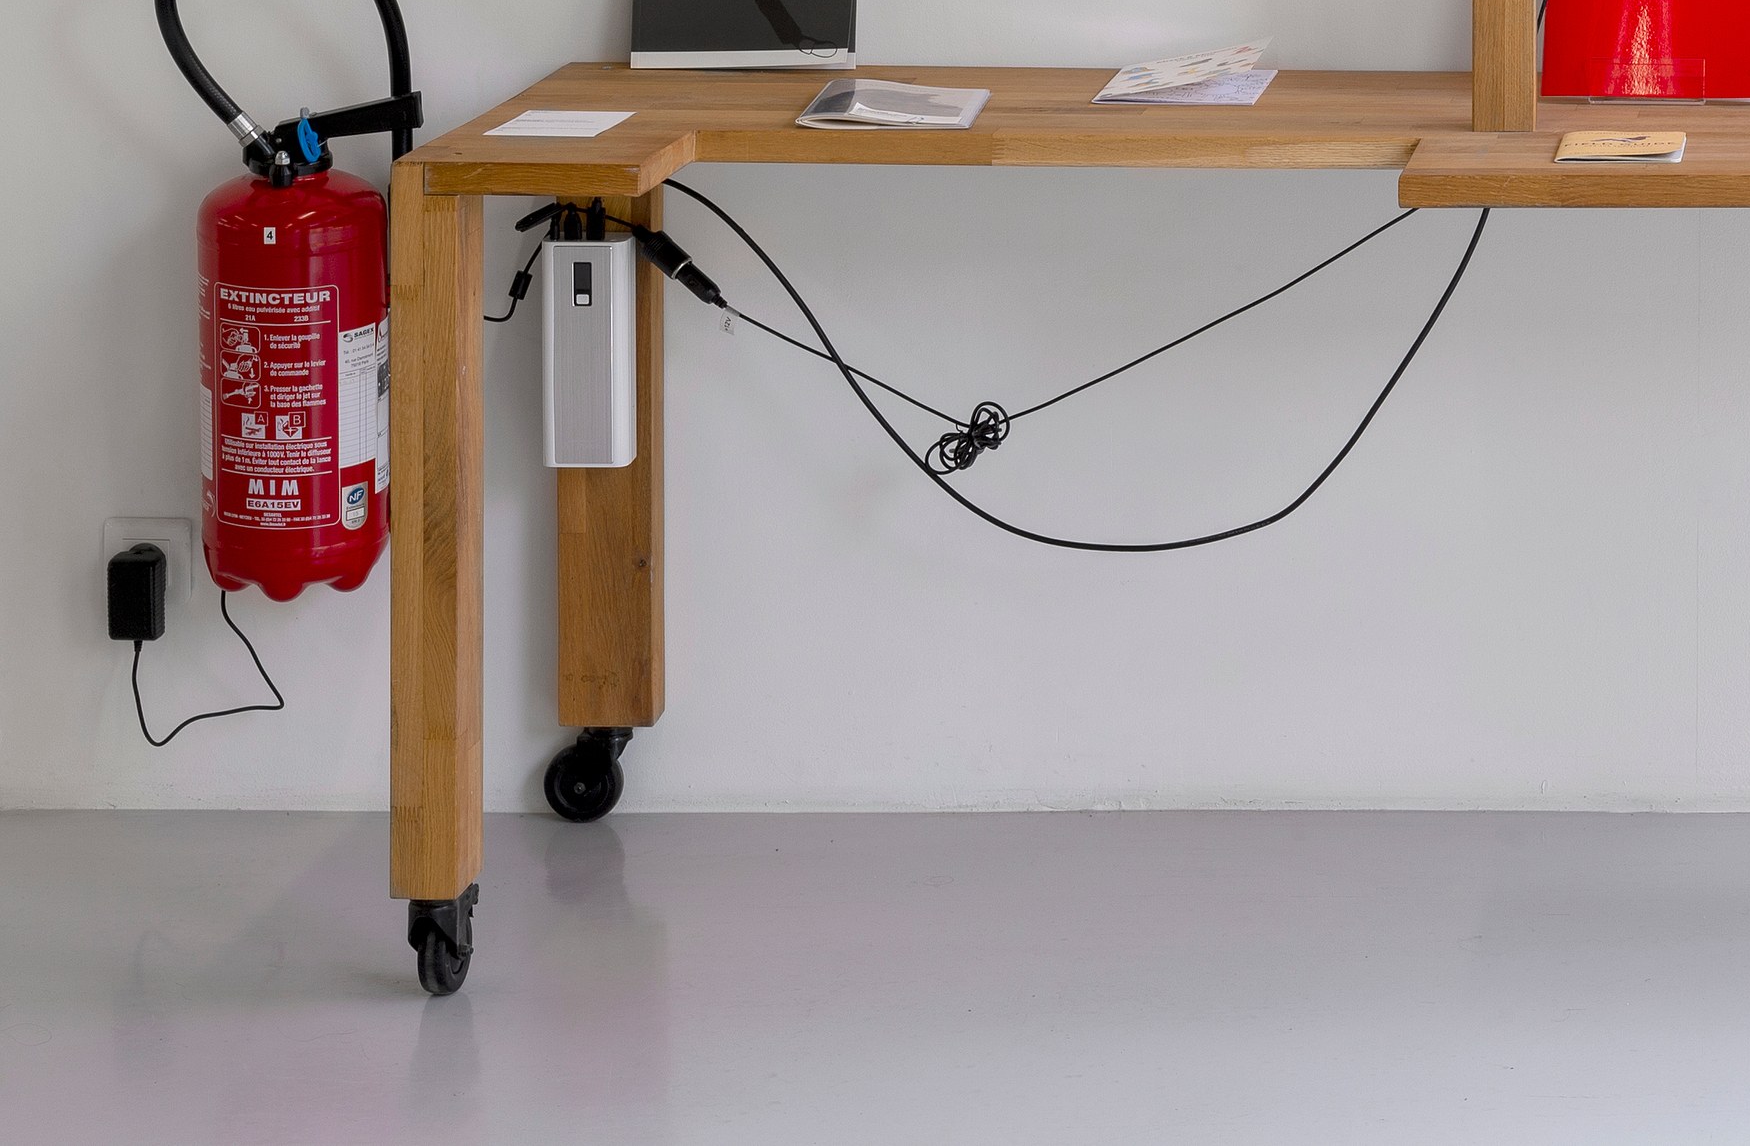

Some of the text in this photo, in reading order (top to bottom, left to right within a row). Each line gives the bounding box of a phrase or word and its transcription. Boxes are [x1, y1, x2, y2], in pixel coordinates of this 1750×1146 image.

[266, 231, 274, 240] 4
[220, 288, 331, 305] EXTINCTEUR
[298, 333, 320, 343] goupille
[278, 340, 301, 349] sécurité
[270, 362, 293, 371] Appuyer
[311, 359, 326, 367] levier
[292, 384, 298, 392] la
[277, 393, 295, 402] diriger
[302, 392, 310, 401] jet
[293, 416, 301, 425] B
[349, 490, 363, 502] NF
[248, 500, 300, 509] E6A15EV
